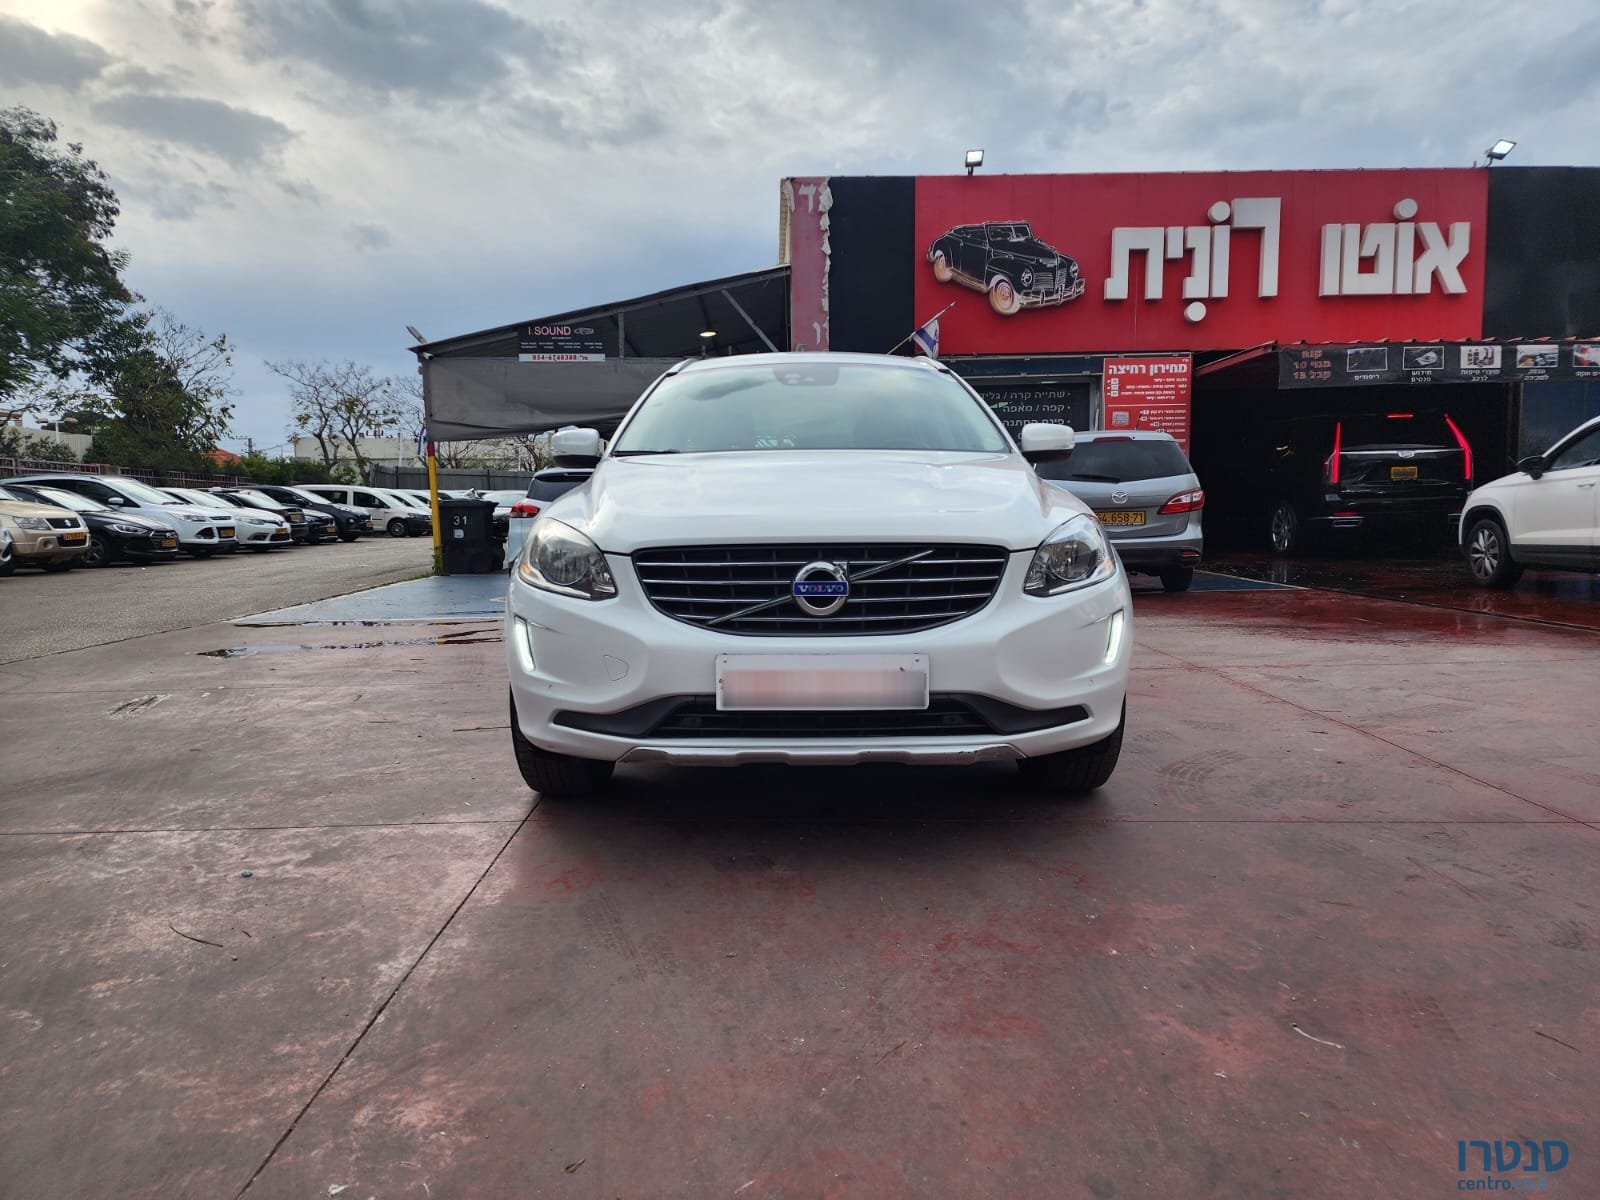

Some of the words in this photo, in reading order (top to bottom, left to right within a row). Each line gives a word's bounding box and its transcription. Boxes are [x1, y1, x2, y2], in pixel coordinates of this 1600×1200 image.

[527, 326, 572, 336] I.SOUND
[1108, 364, 1147, 375] רחיצה
[1149, 363, 1188, 377] מחירון
[1010, 392, 1031, 401] קרה
[1035, 391, 1065, 399] שתייה
[1002, 405, 1032, 413] מאפה
[1042, 404, 1065, 413] קפה
[453, 515, 467, 526] 31
[798, 584, 844, 593] VOLVO
